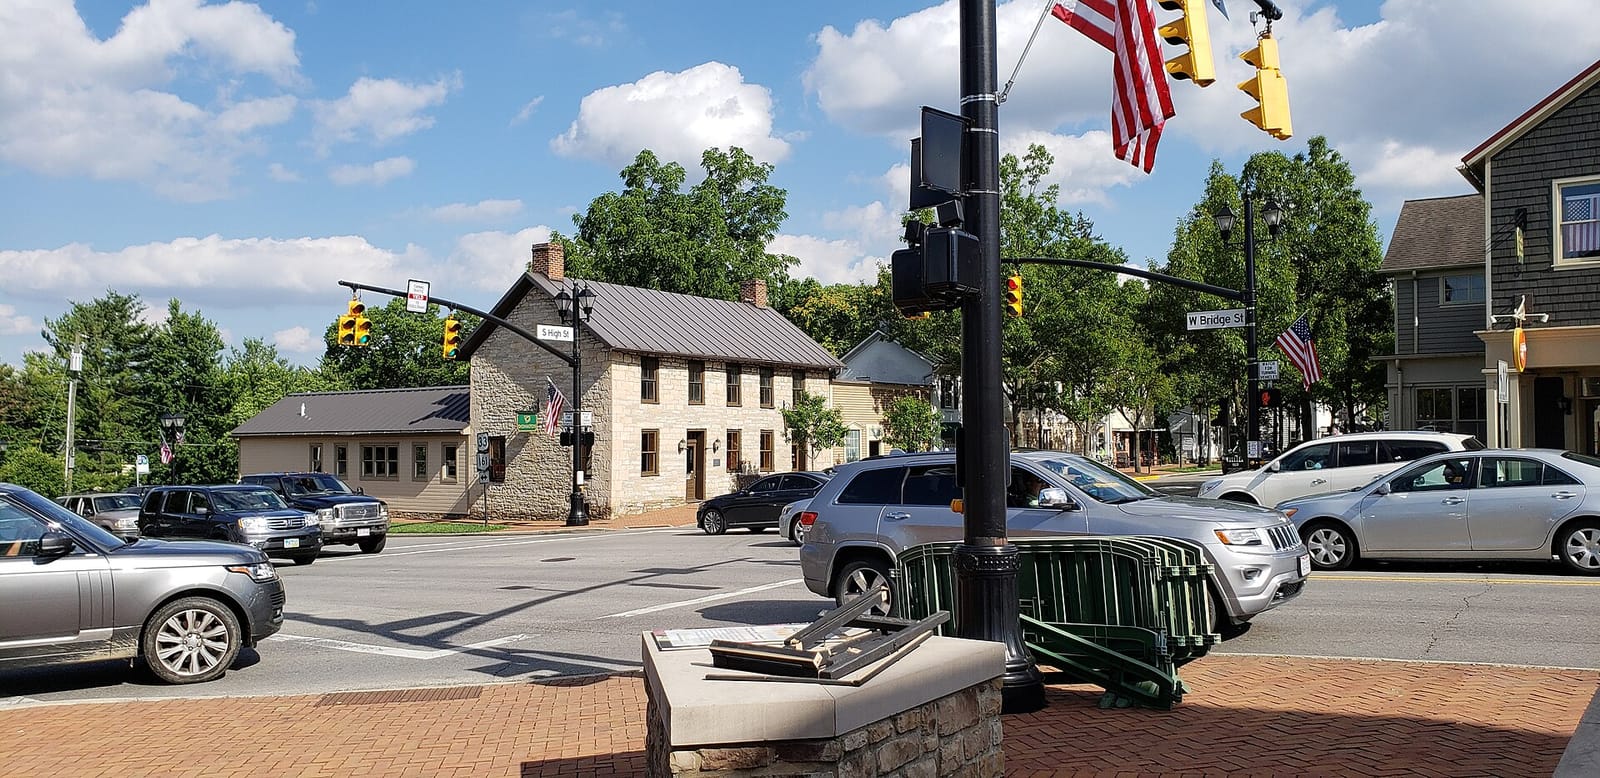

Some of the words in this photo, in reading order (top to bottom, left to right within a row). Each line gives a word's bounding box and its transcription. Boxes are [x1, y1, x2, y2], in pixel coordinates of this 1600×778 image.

[1188, 316, 1197, 326] W
[1200, 314, 1231, 326] Bridge
[1234, 312, 1244, 323] St
[542, 328, 547, 337] S
[547, 328, 562, 340] High
[563, 329, 570, 338] St
[478, 436, 487, 448] 33
[478, 455, 488, 466] 161
